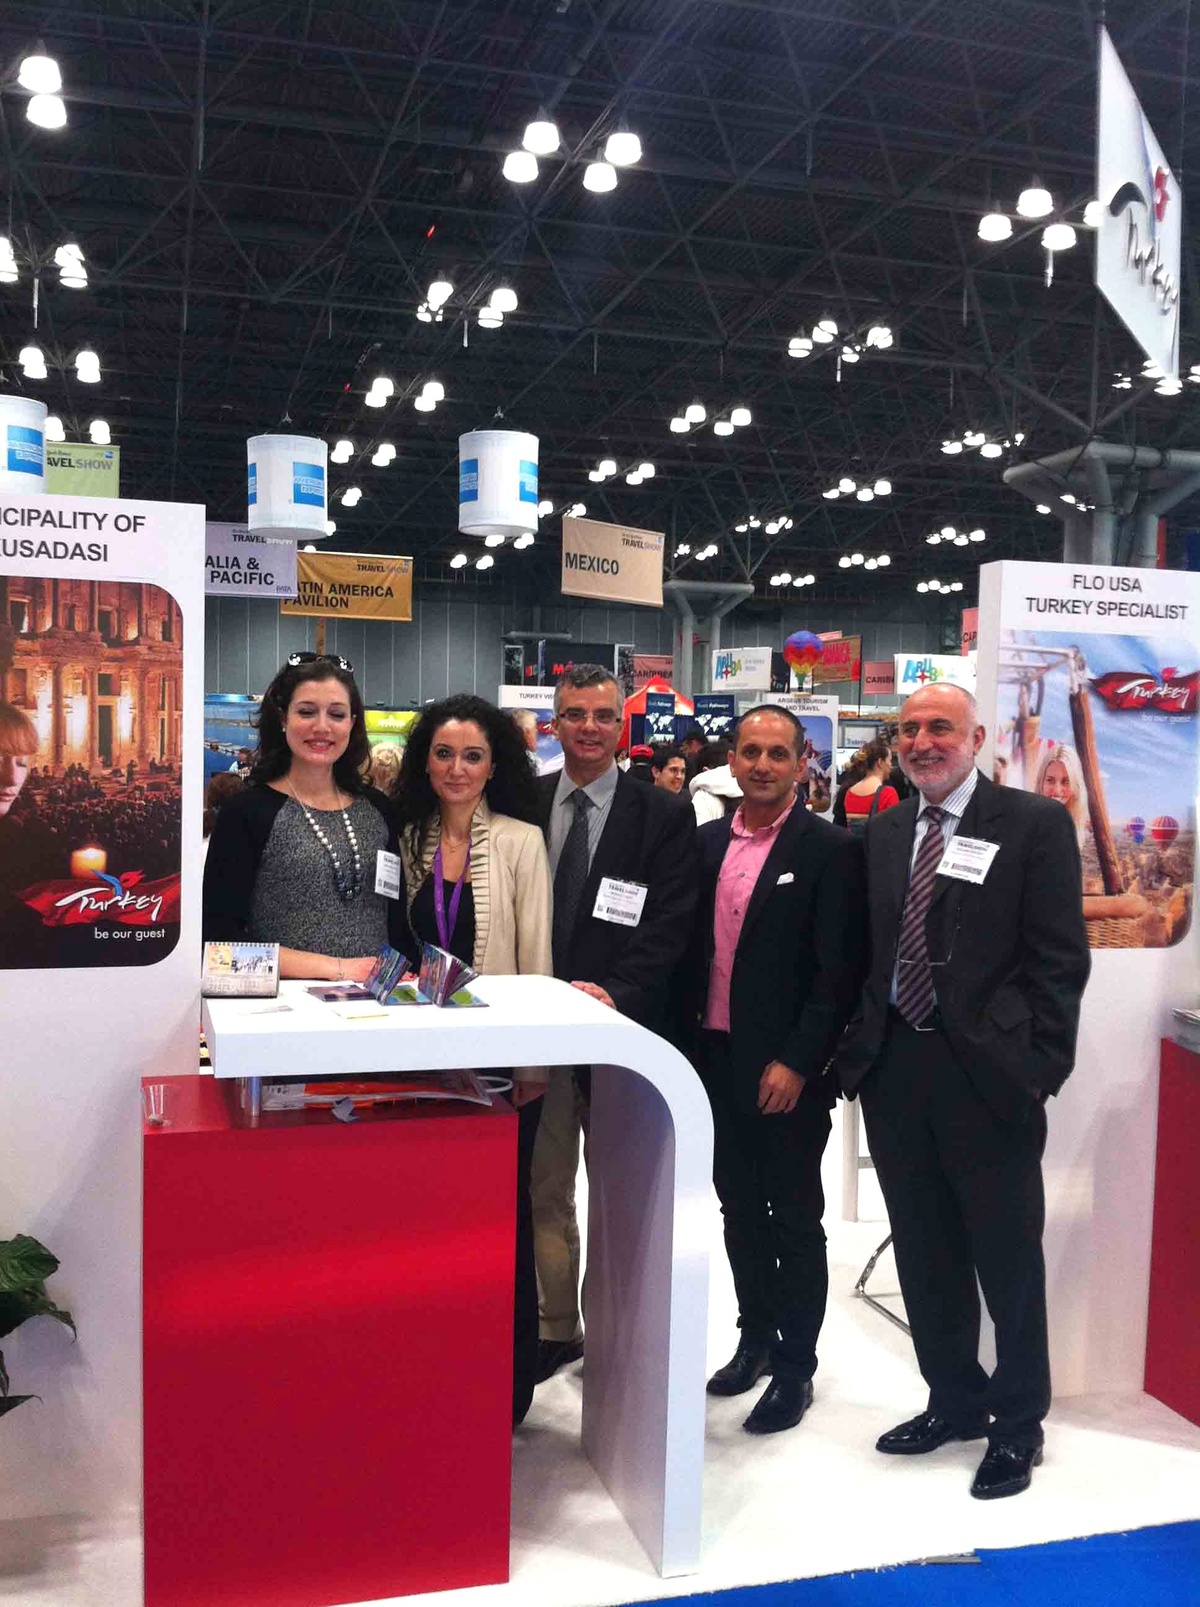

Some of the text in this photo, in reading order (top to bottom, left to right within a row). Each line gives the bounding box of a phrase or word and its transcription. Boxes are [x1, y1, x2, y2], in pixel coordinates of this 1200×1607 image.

[77, 459, 113, 470] SHOW
[114, 514, 146, 533] OF
[232, 534, 267, 544] TRAVEL
[0, 538, 108, 562] USADASI
[205, 555, 260, 570] ALIA &
[357, 564, 385, 572] TRAVEL
[565, 552, 620, 575] MEXICO
[210, 570, 275, 585] PACIFIC
[1072, 574, 1142, 593] FLO USA
[297, 581, 394, 598] TIN AMERICA
[1025, 597, 1189, 620] TURKEY SPECIALIST
[1116, 678, 1190, 709] Turkey
[55, 886, 163, 922] Turkey
[94, 927, 166, 941] be our guest
